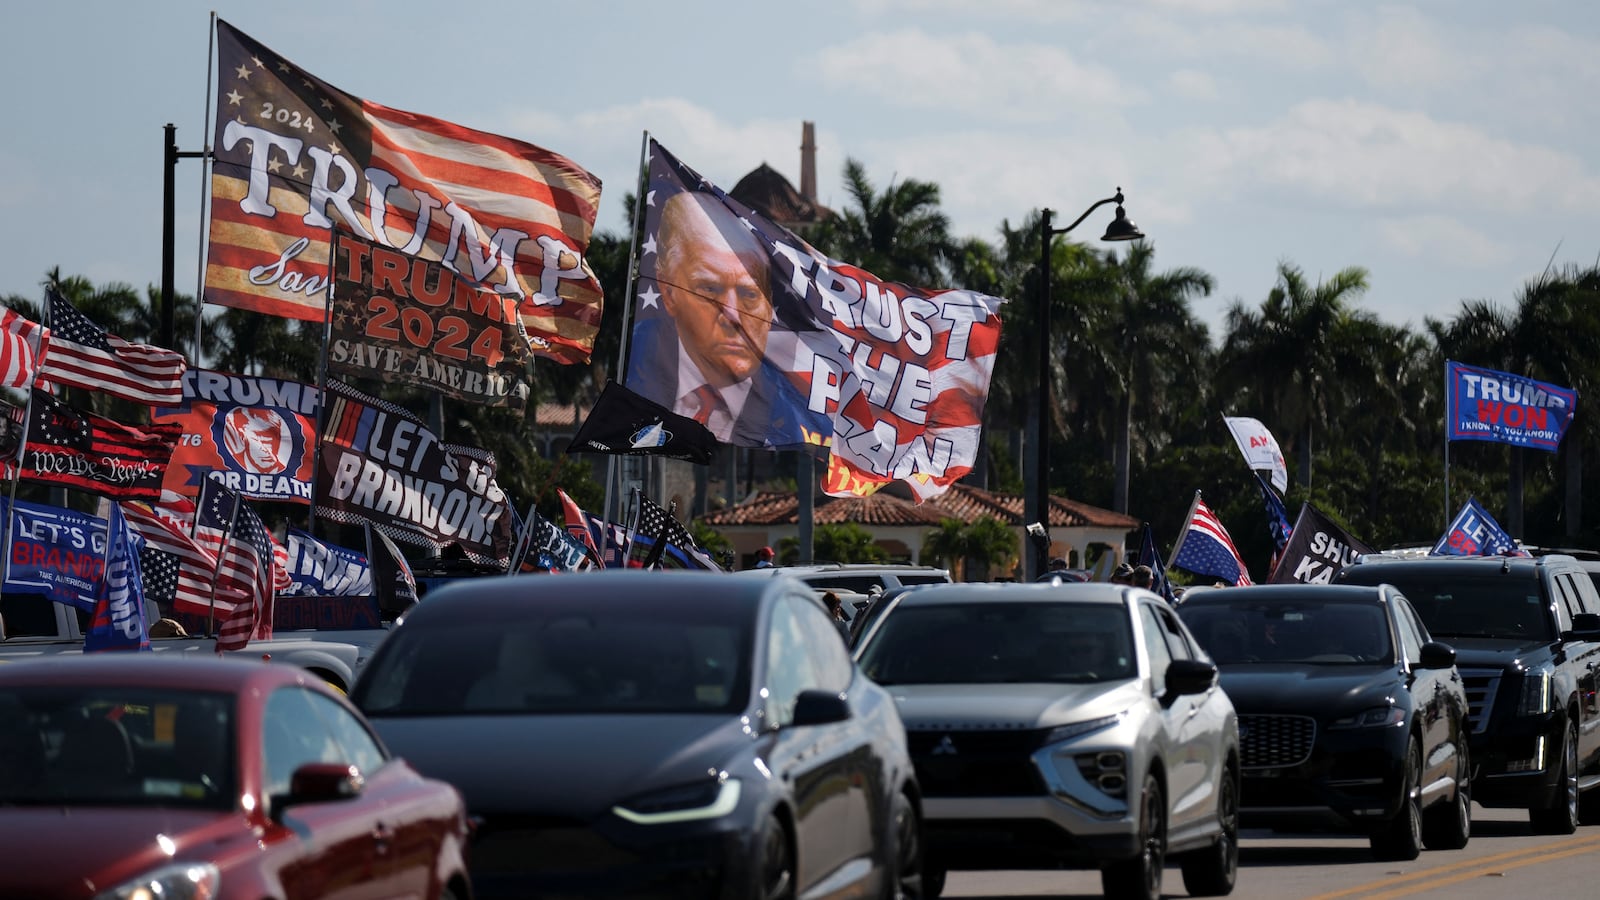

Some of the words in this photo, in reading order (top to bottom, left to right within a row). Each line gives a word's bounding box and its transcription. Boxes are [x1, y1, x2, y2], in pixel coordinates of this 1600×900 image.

[259, 102, 315, 133] 2024
[222, 120, 601, 309] TRUMP
[248, 235, 336, 299] Sav
[775, 240, 988, 361] TRUST
[365, 296, 505, 368] 2024
[180, 369, 326, 415] TRUMP
[331, 339, 402, 373] SAVE
[411, 355, 531, 401] AMERICA
[828, 325, 933, 426] THE
[1462, 374, 1565, 408] TRUMP
[808, 352, 953, 480] PLAN
[1466, 422, 1491, 431] KNOW
[1504, 427, 1522, 436] YOU
[1524, 429, 1553, 440] KNOW
[1477, 399, 1547, 431] WON
[369, 412, 461, 483] LET'S
[209, 470, 242, 490] OR
[245, 473, 313, 500] DEATH
[328, 451, 504, 547] BRANDON!
[18, 515, 86, 549] LET'S
[1310, 531, 1362, 568] SHU
[1462, 513, 1509, 555] LET'S
[13, 541, 105, 583] BRANDO
[1293, 555, 1334, 585] KA
